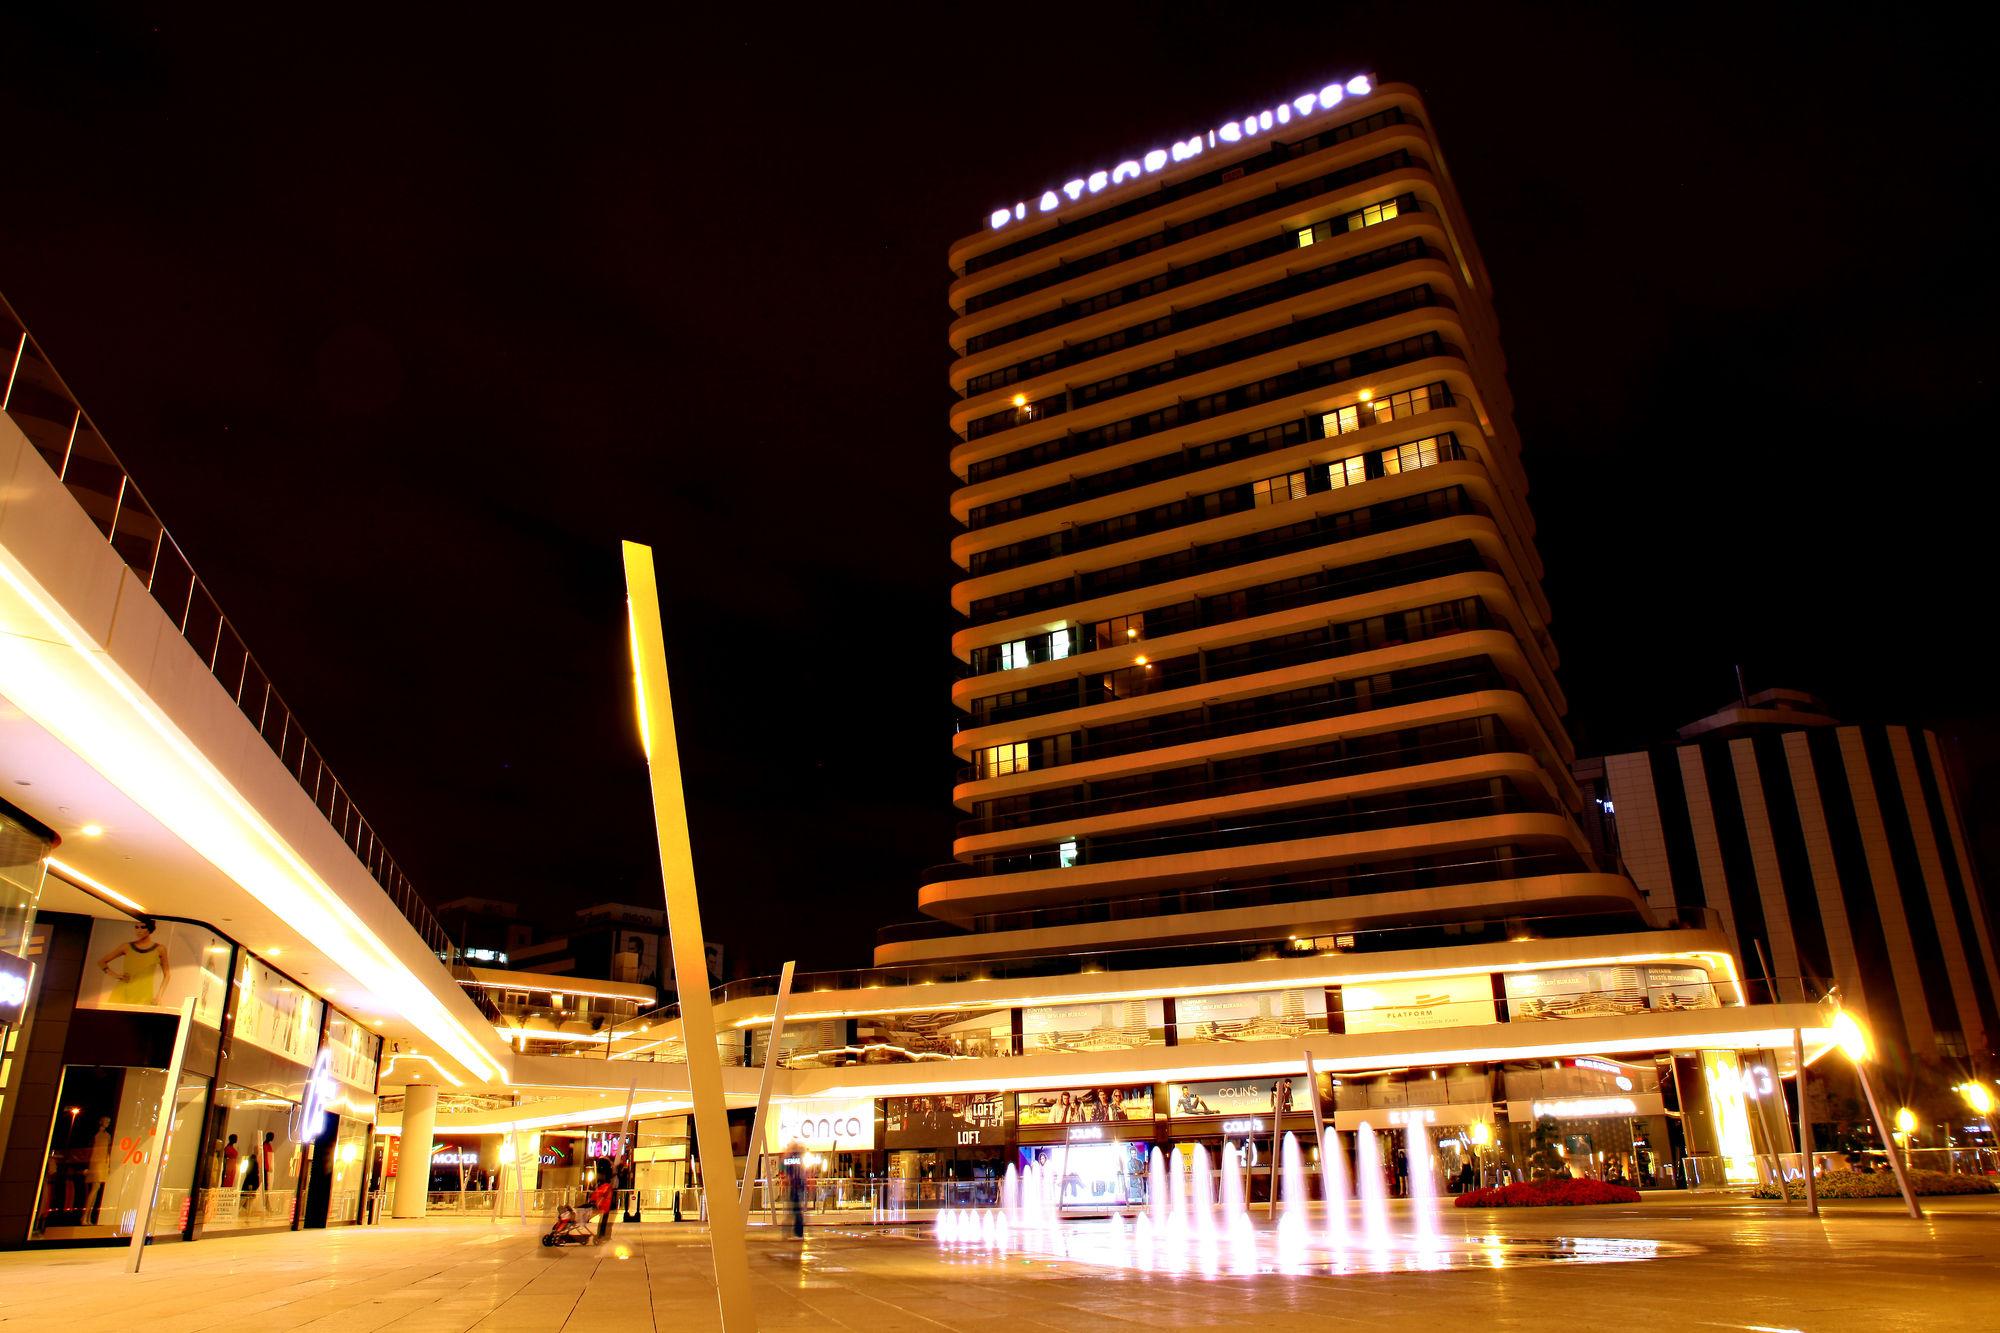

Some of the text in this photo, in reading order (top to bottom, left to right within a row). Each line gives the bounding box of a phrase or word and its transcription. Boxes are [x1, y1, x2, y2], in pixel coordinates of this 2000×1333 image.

[1386, 1010, 1433, 1018] PLATFORM
[1218, 1085, 1258, 1098] COLIN'S
[791, 1117, 861, 1139] anca
